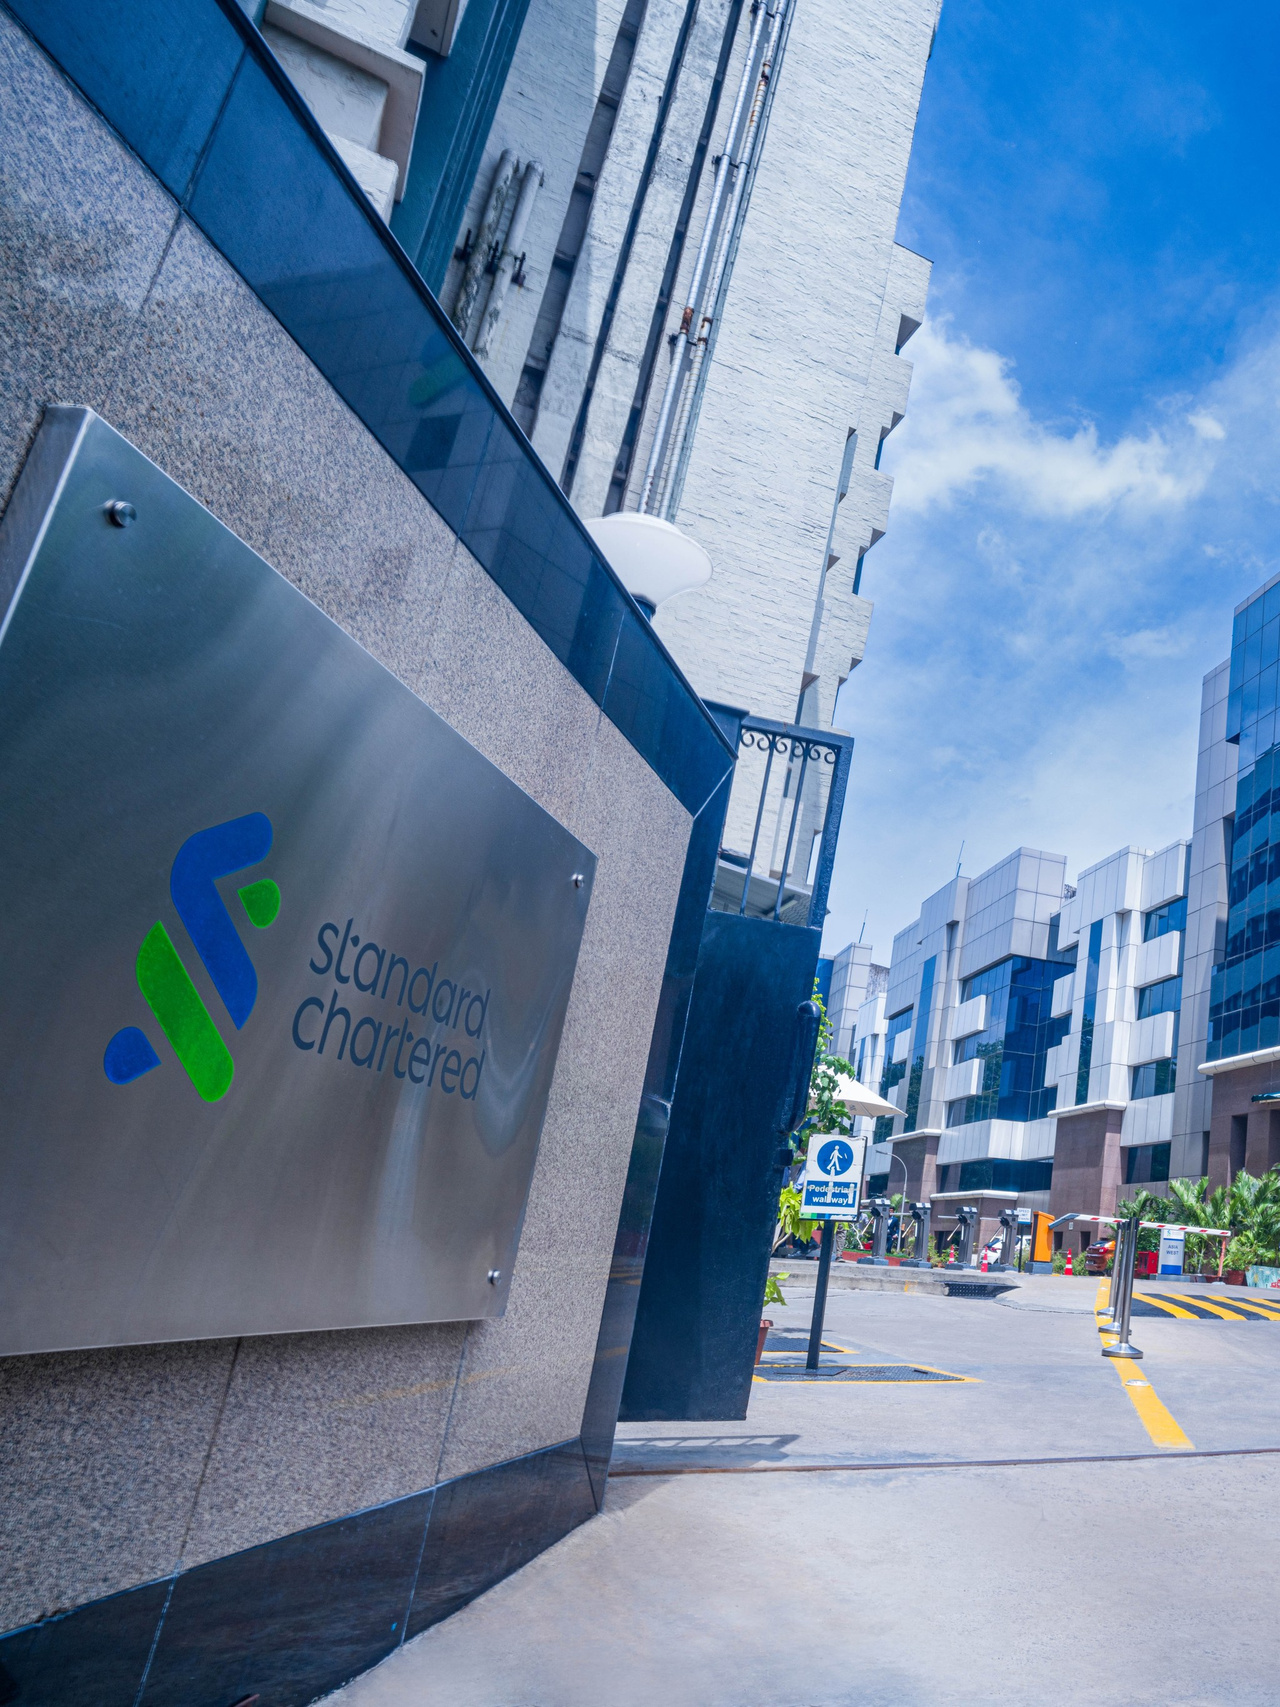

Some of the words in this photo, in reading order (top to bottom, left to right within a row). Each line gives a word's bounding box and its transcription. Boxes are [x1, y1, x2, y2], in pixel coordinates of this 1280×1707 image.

[309, 917, 491, 1039] standard
[291, 988, 486, 1101] chartered
[808, 1184, 854, 1194] Pedetria
[812, 1195, 848, 1206] walway
